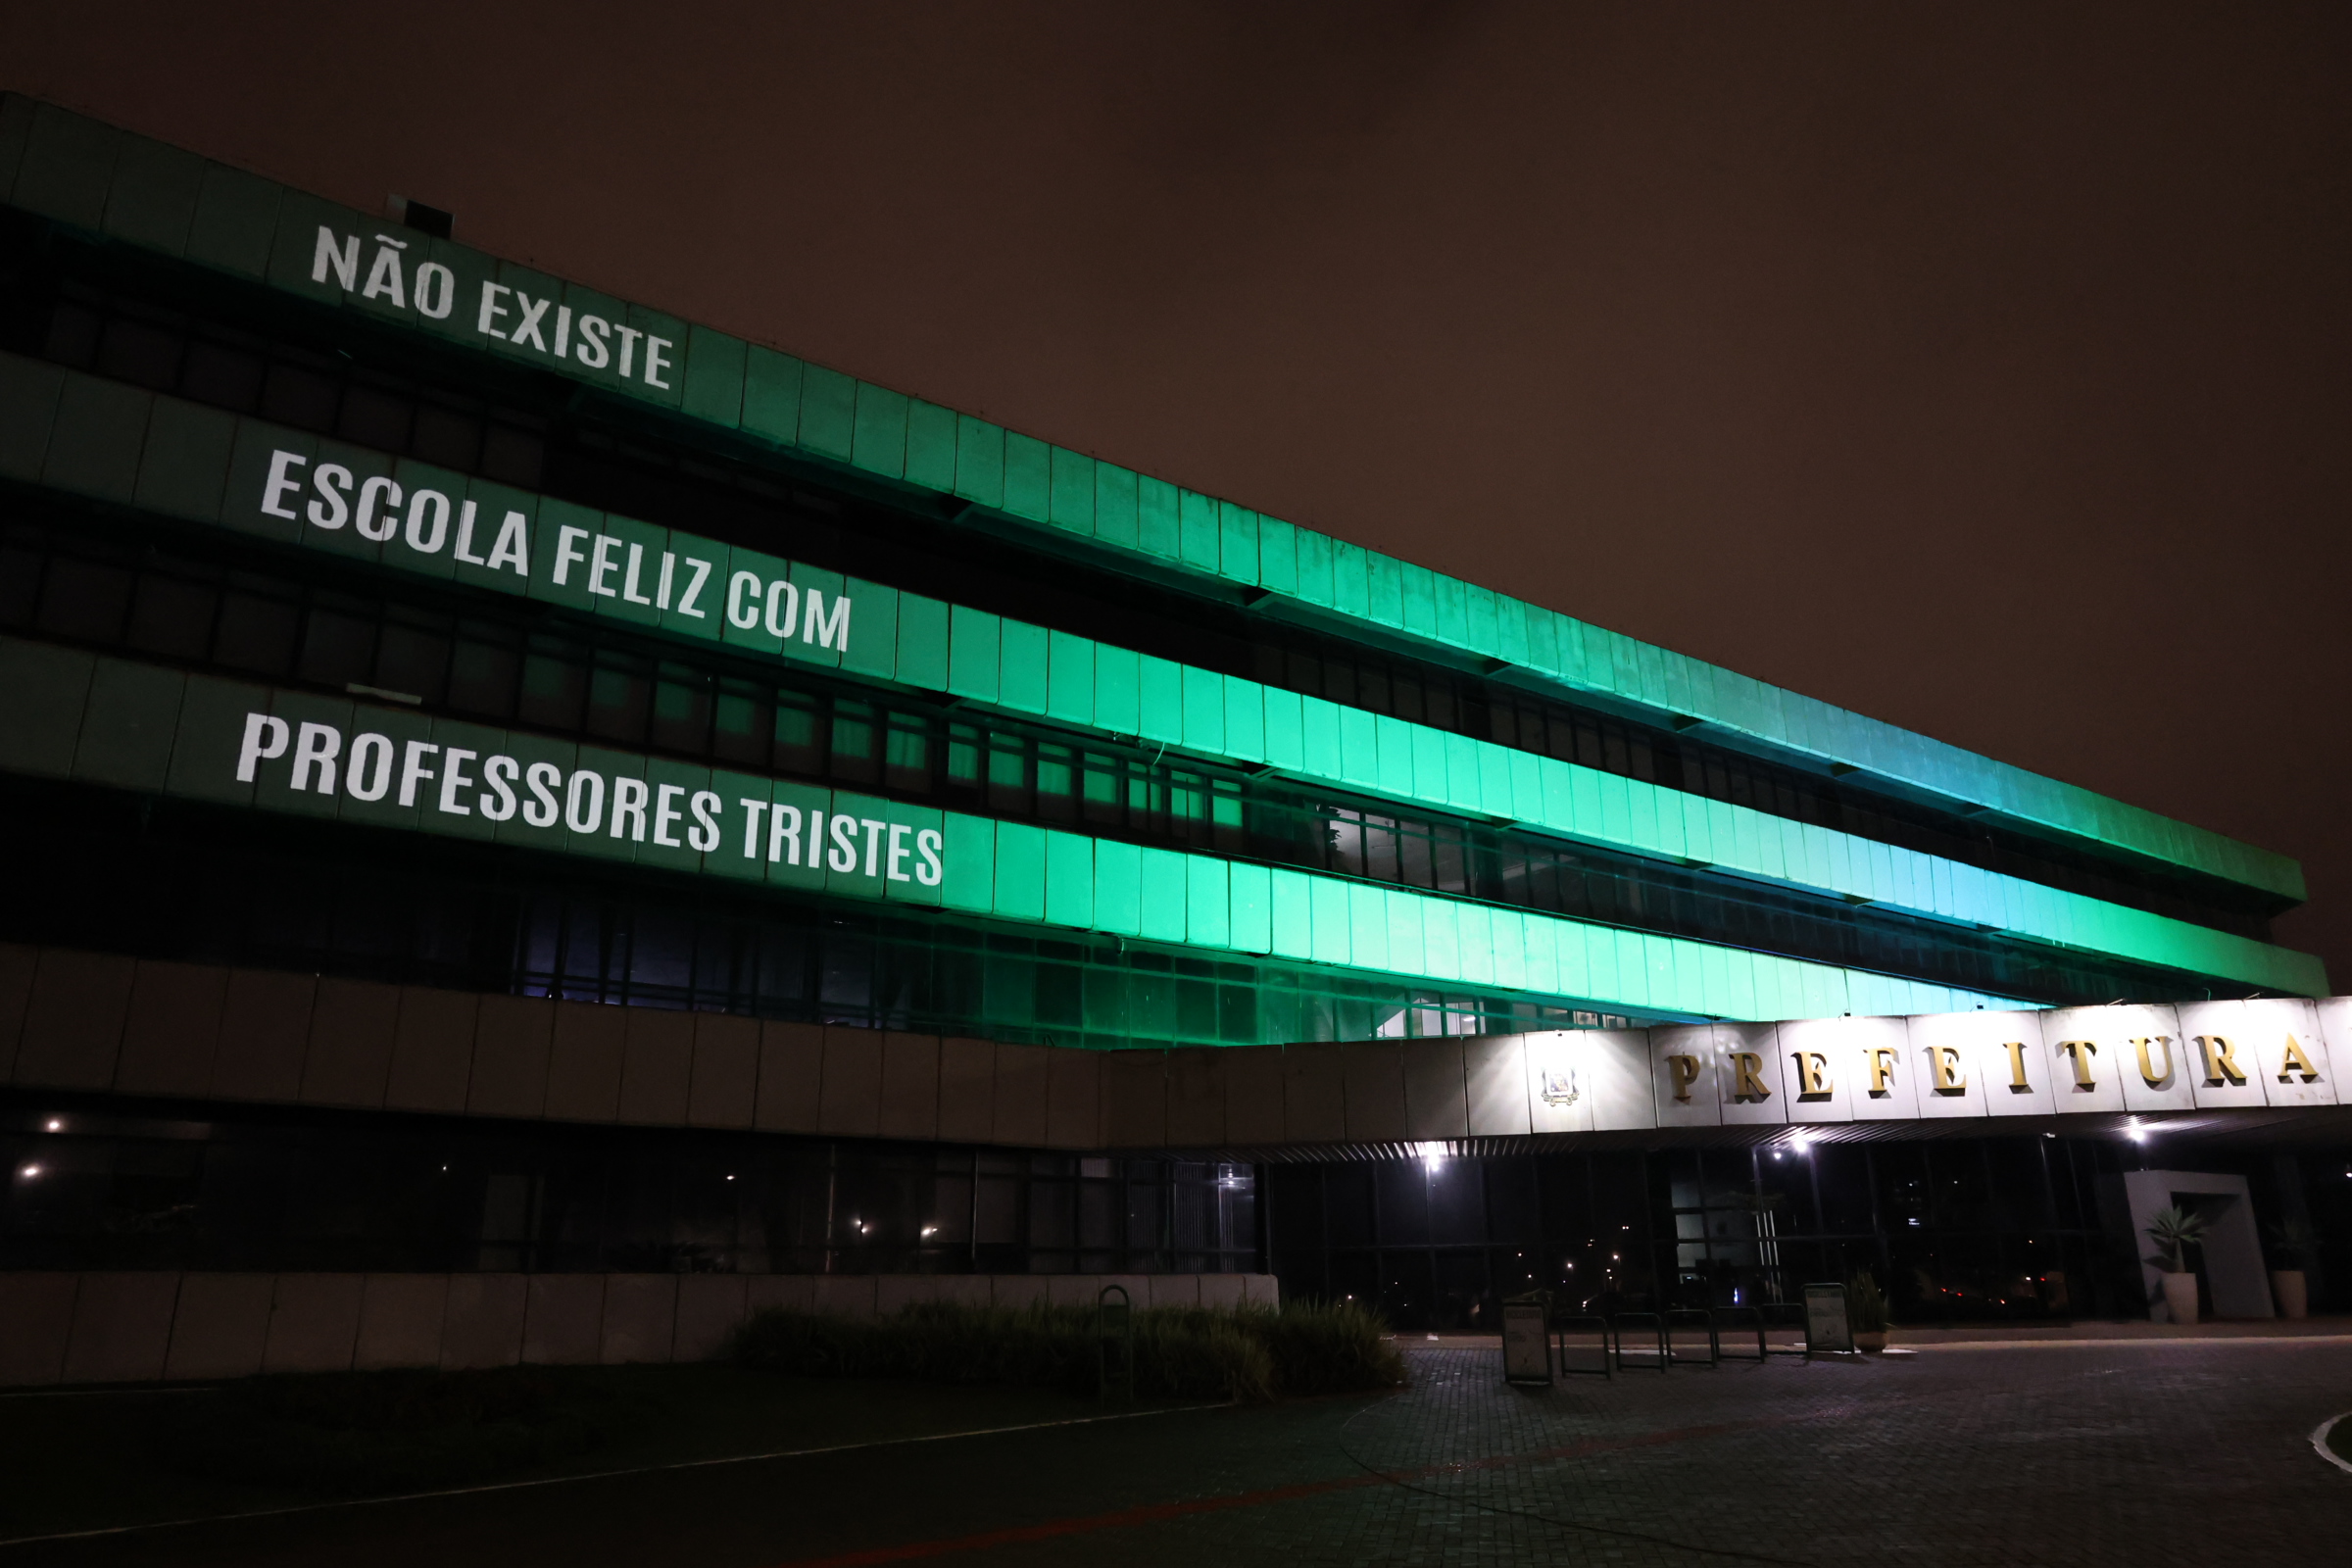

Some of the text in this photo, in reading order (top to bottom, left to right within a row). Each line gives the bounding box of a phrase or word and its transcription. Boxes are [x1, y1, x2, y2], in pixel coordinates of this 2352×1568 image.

[312, 224, 673, 391] NÃO EXISTE
[261, 449, 852, 654] ESCOLA FELIZ COM
[236, 711, 944, 887] PROFESSORES TRISTES
[1667, 1032, 2320, 1102] PREFEITURA
